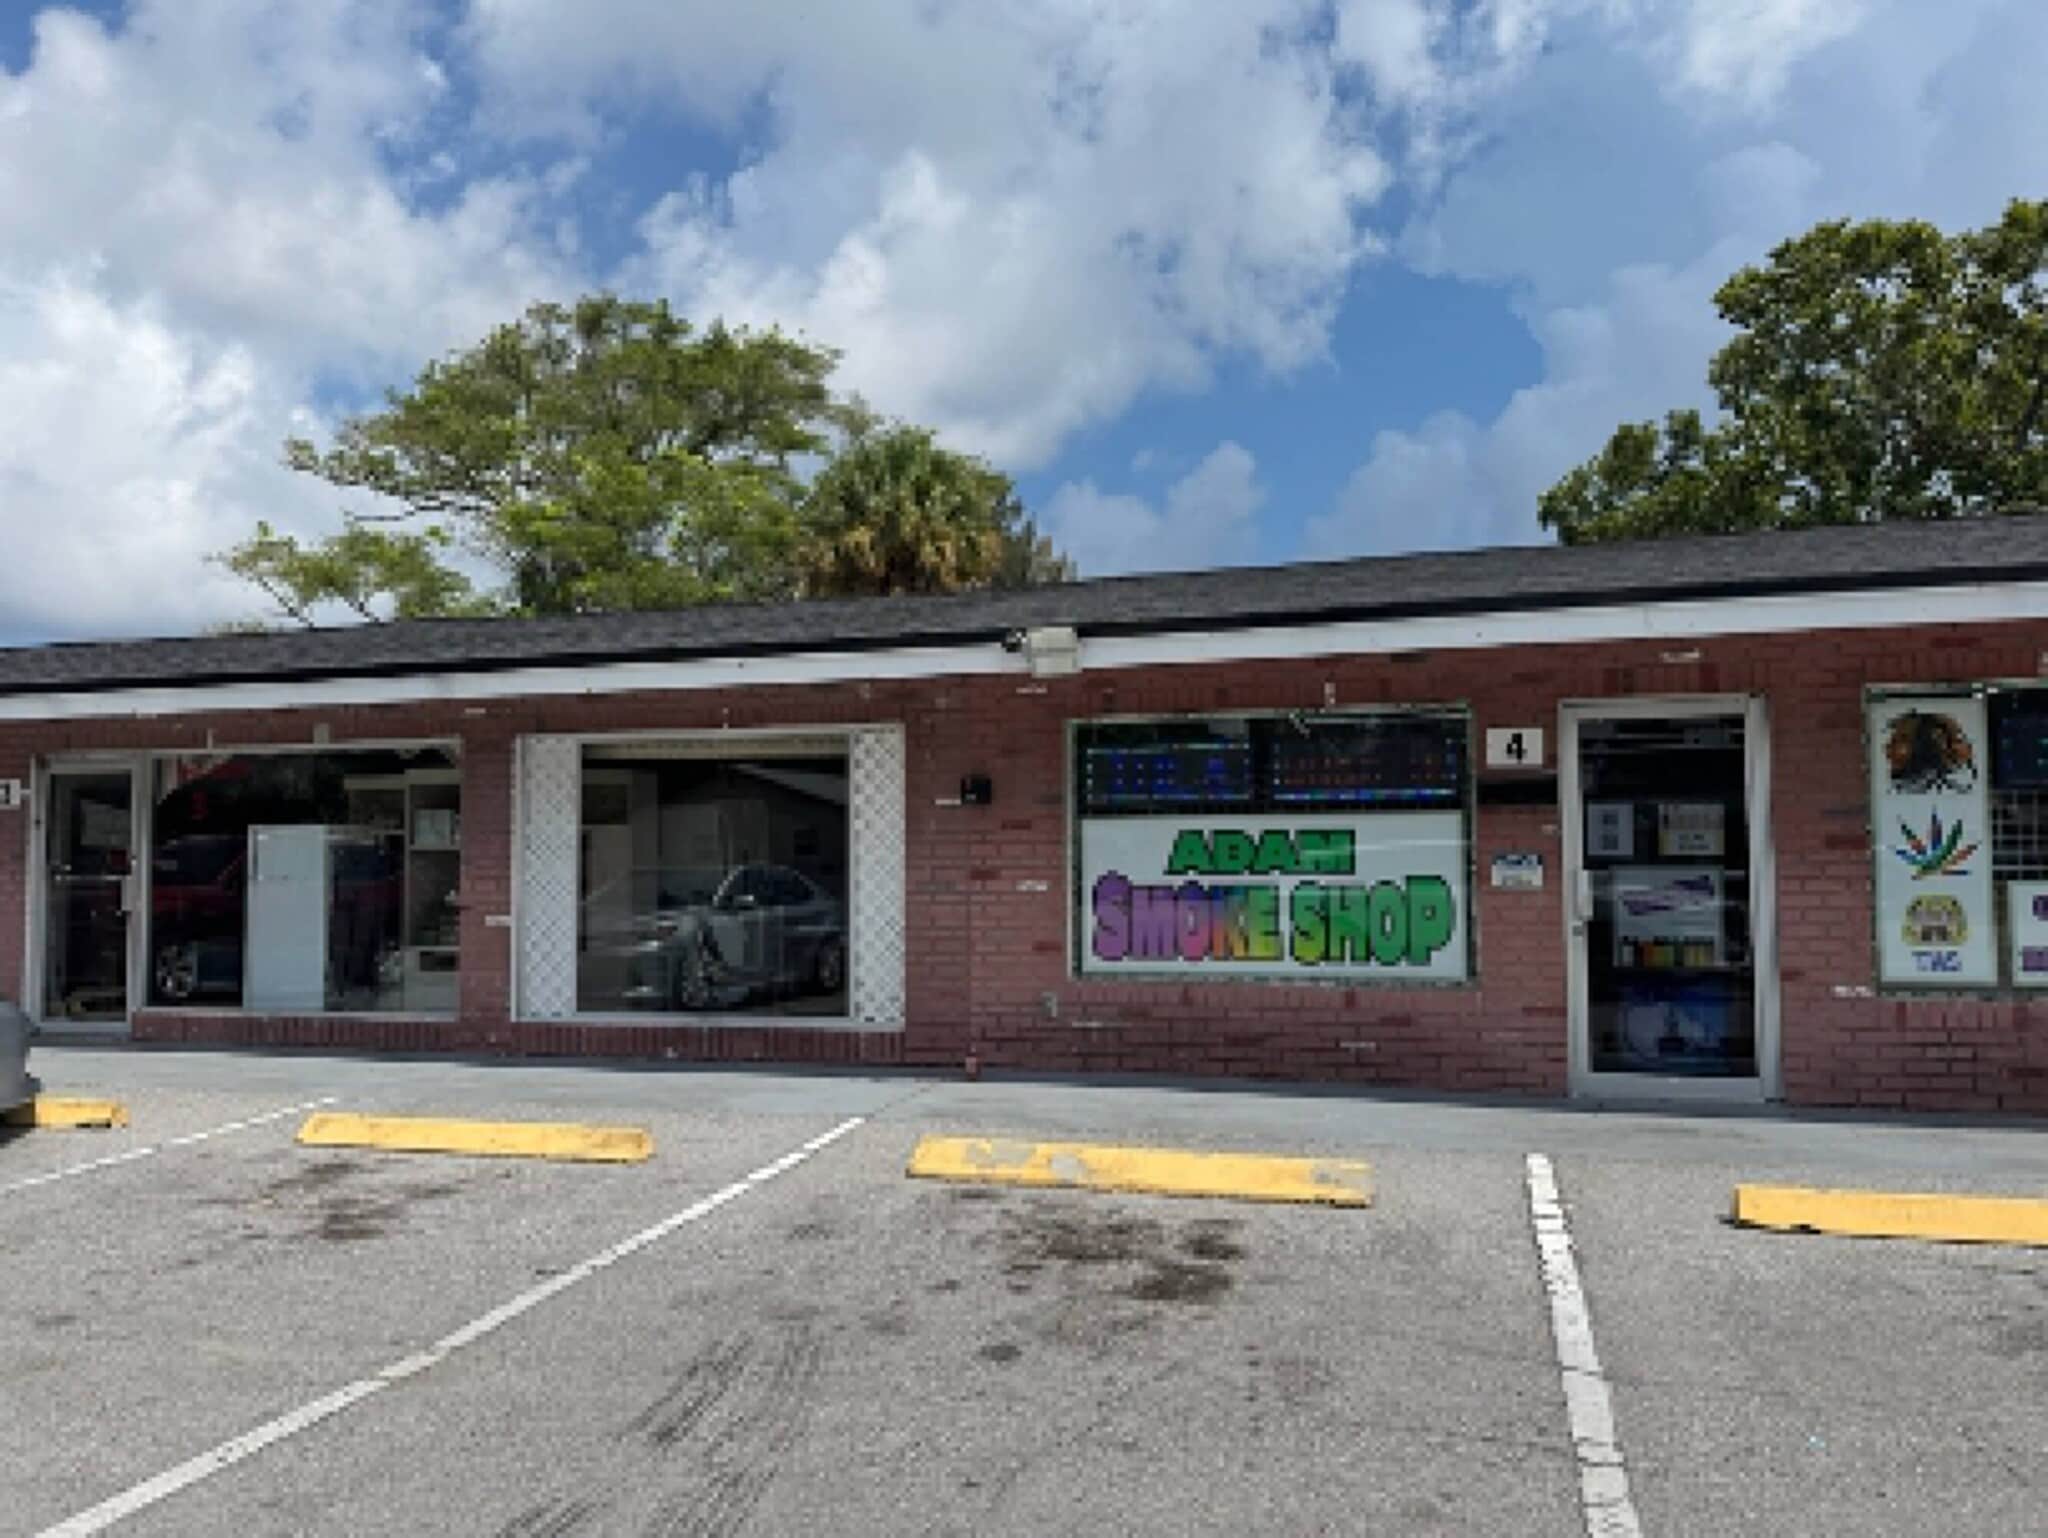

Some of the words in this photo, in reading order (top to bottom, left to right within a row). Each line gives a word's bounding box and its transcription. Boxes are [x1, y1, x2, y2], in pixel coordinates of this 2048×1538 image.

[1505, 733, 1529, 762] 4
[1164, 829, 1356, 875] ADAM
[1093, 871, 1284, 961] SMOKE
[1290, 875, 1455, 966] SHOP
